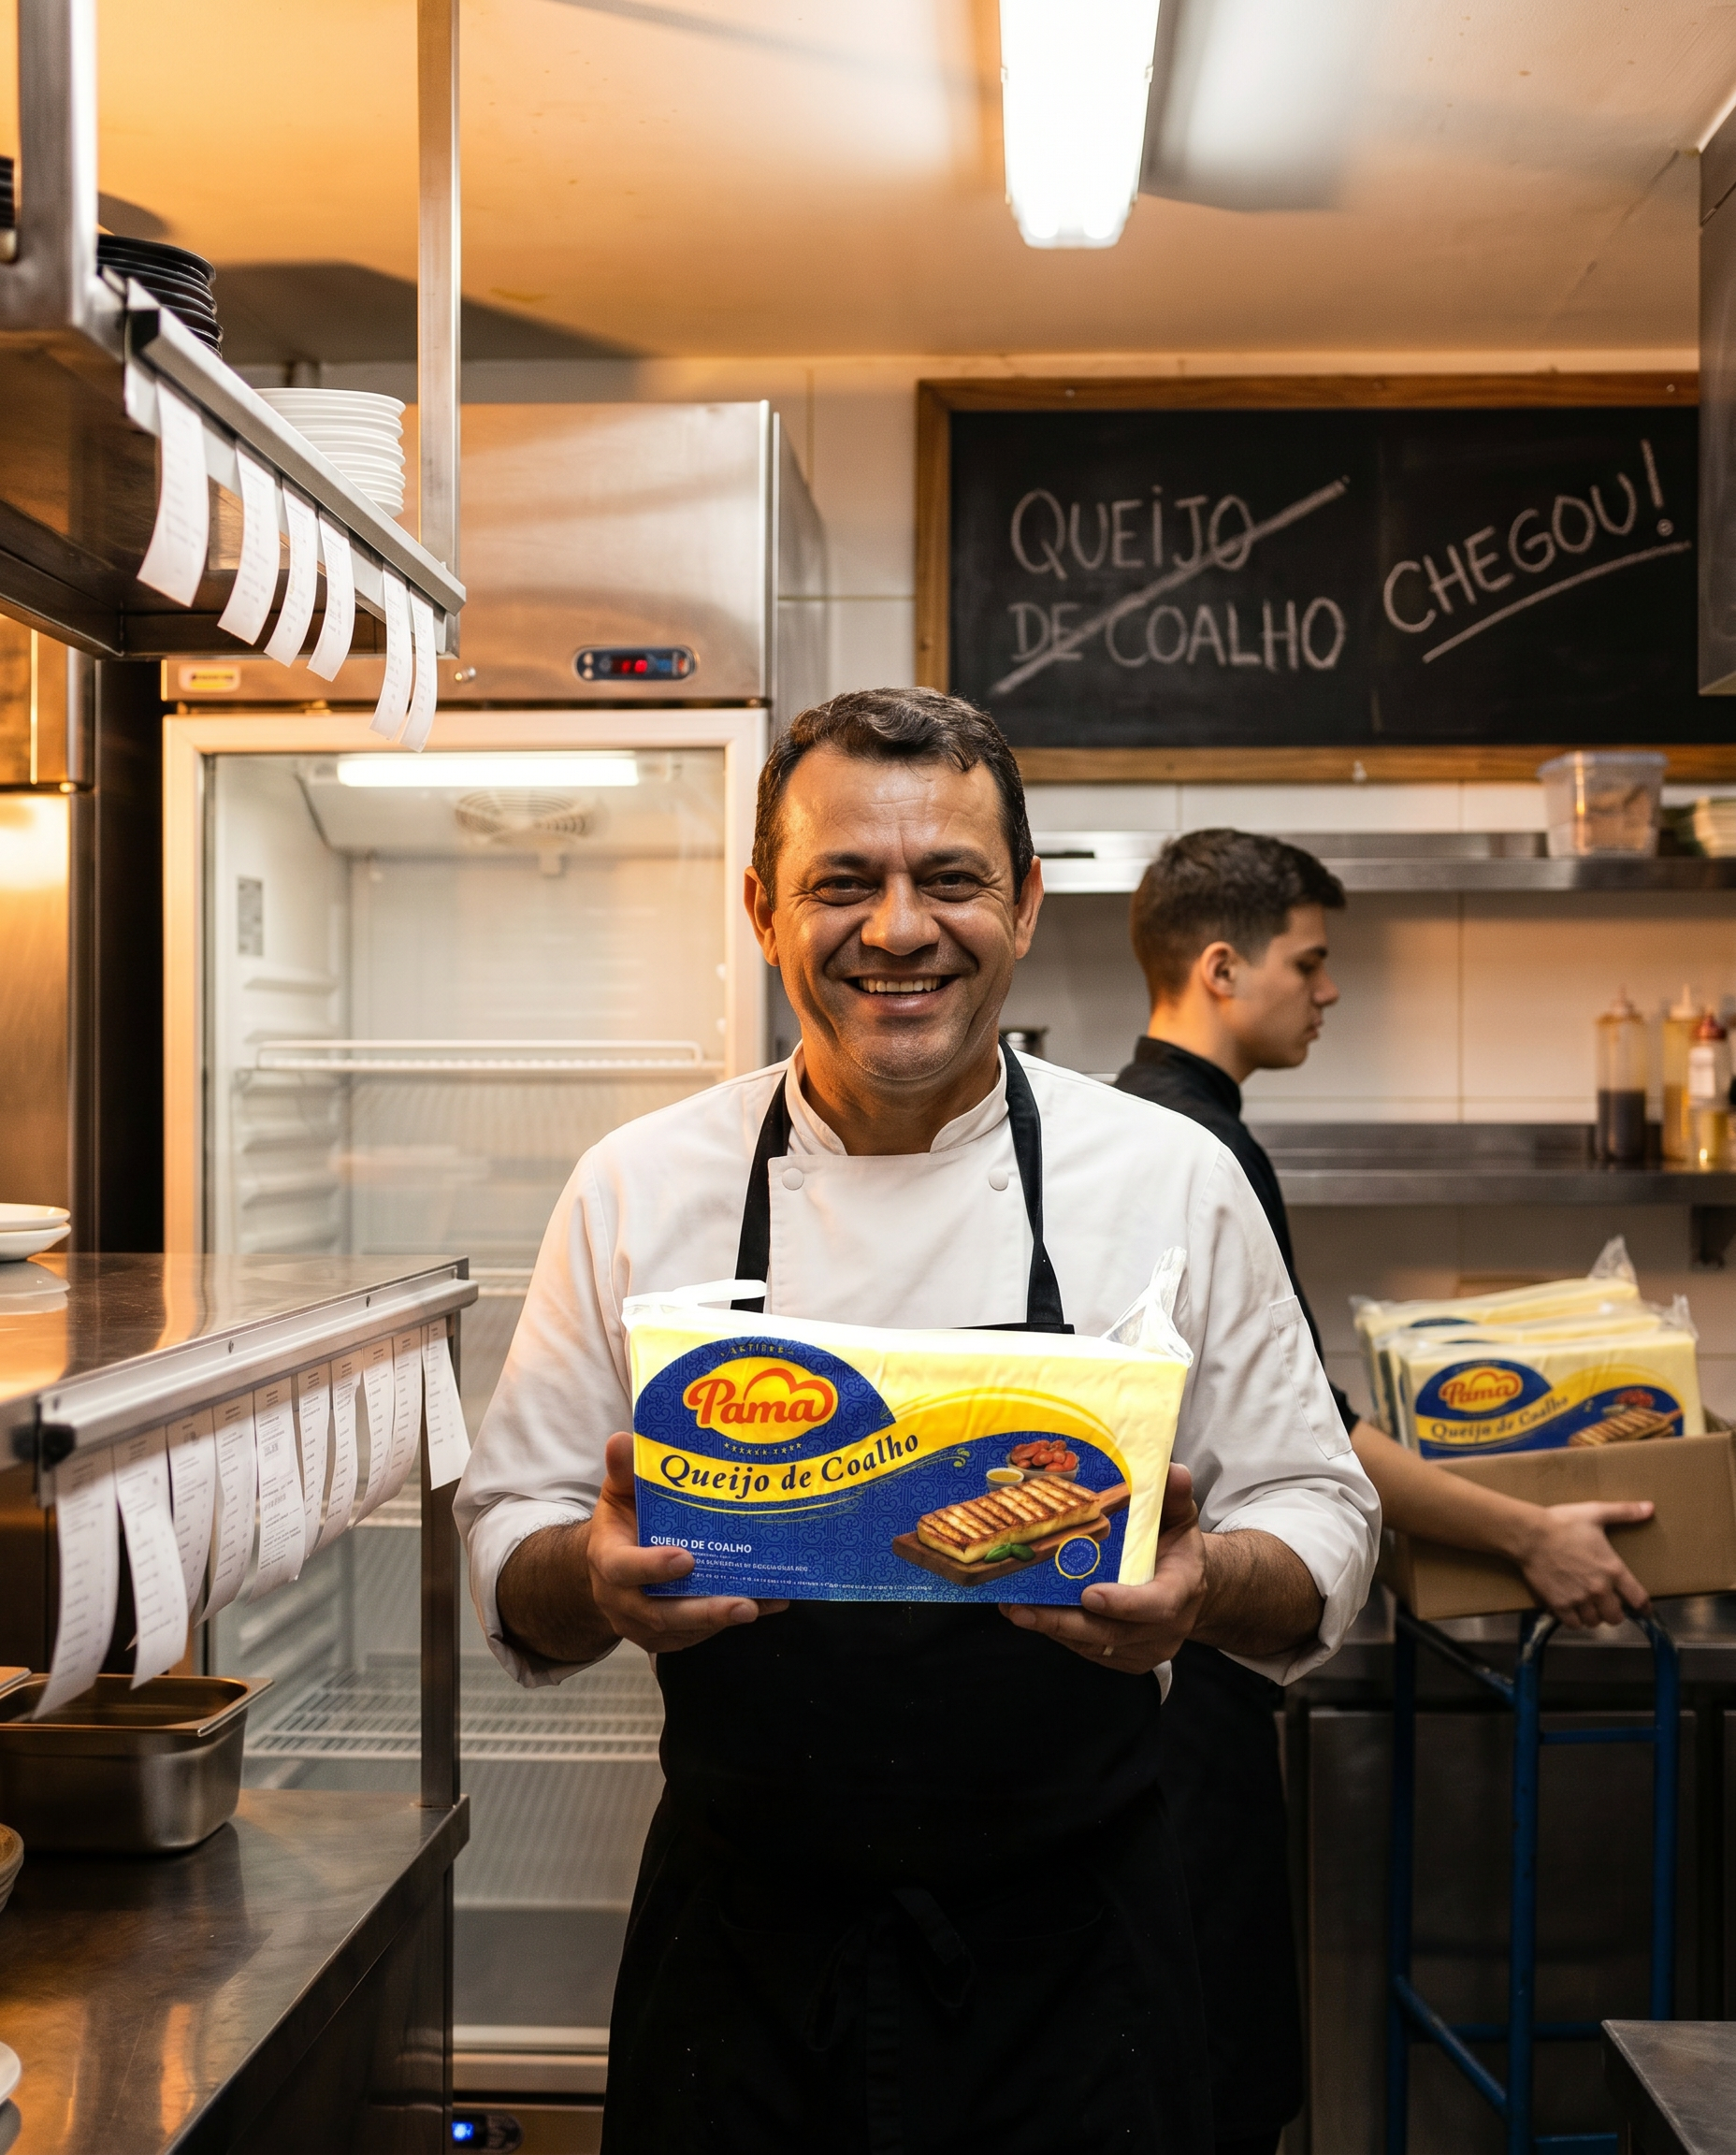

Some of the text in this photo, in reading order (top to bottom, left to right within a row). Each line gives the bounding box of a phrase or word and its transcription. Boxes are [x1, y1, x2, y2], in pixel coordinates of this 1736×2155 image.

[1382, 440, 1675, 634] CHEGOU!
[1007, 596, 1346, 673] DE COALHO
[687, 1368, 834, 1425] Pama
[1441, 1370, 1520, 1407] Pama
[660, 1434, 919, 1499] Queijo de Coalho
[650, 1535, 752, 1554] QUEIJO DE COALHO
